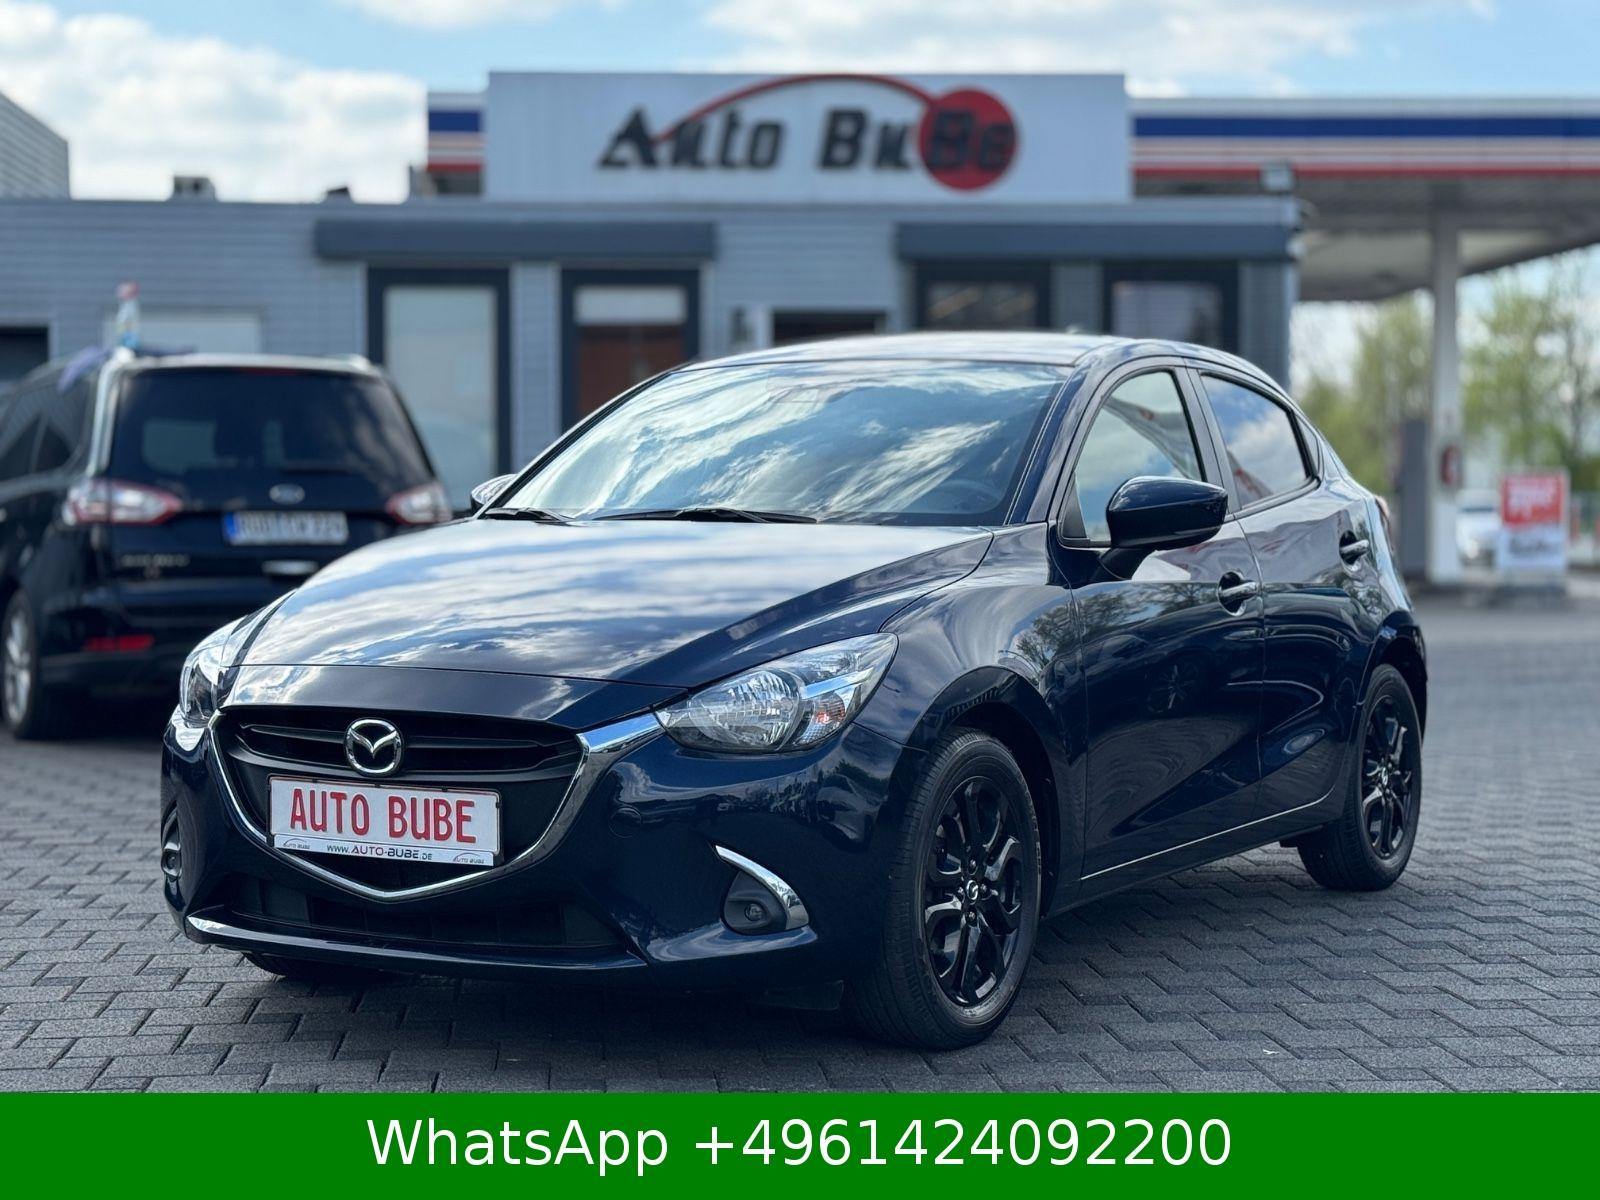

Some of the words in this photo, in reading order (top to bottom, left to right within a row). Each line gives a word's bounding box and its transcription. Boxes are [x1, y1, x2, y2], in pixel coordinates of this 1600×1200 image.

[598, 106, 786, 169] Auto
[290, 788, 370, 836] AUTO
[388, 795, 477, 844] BUBE
